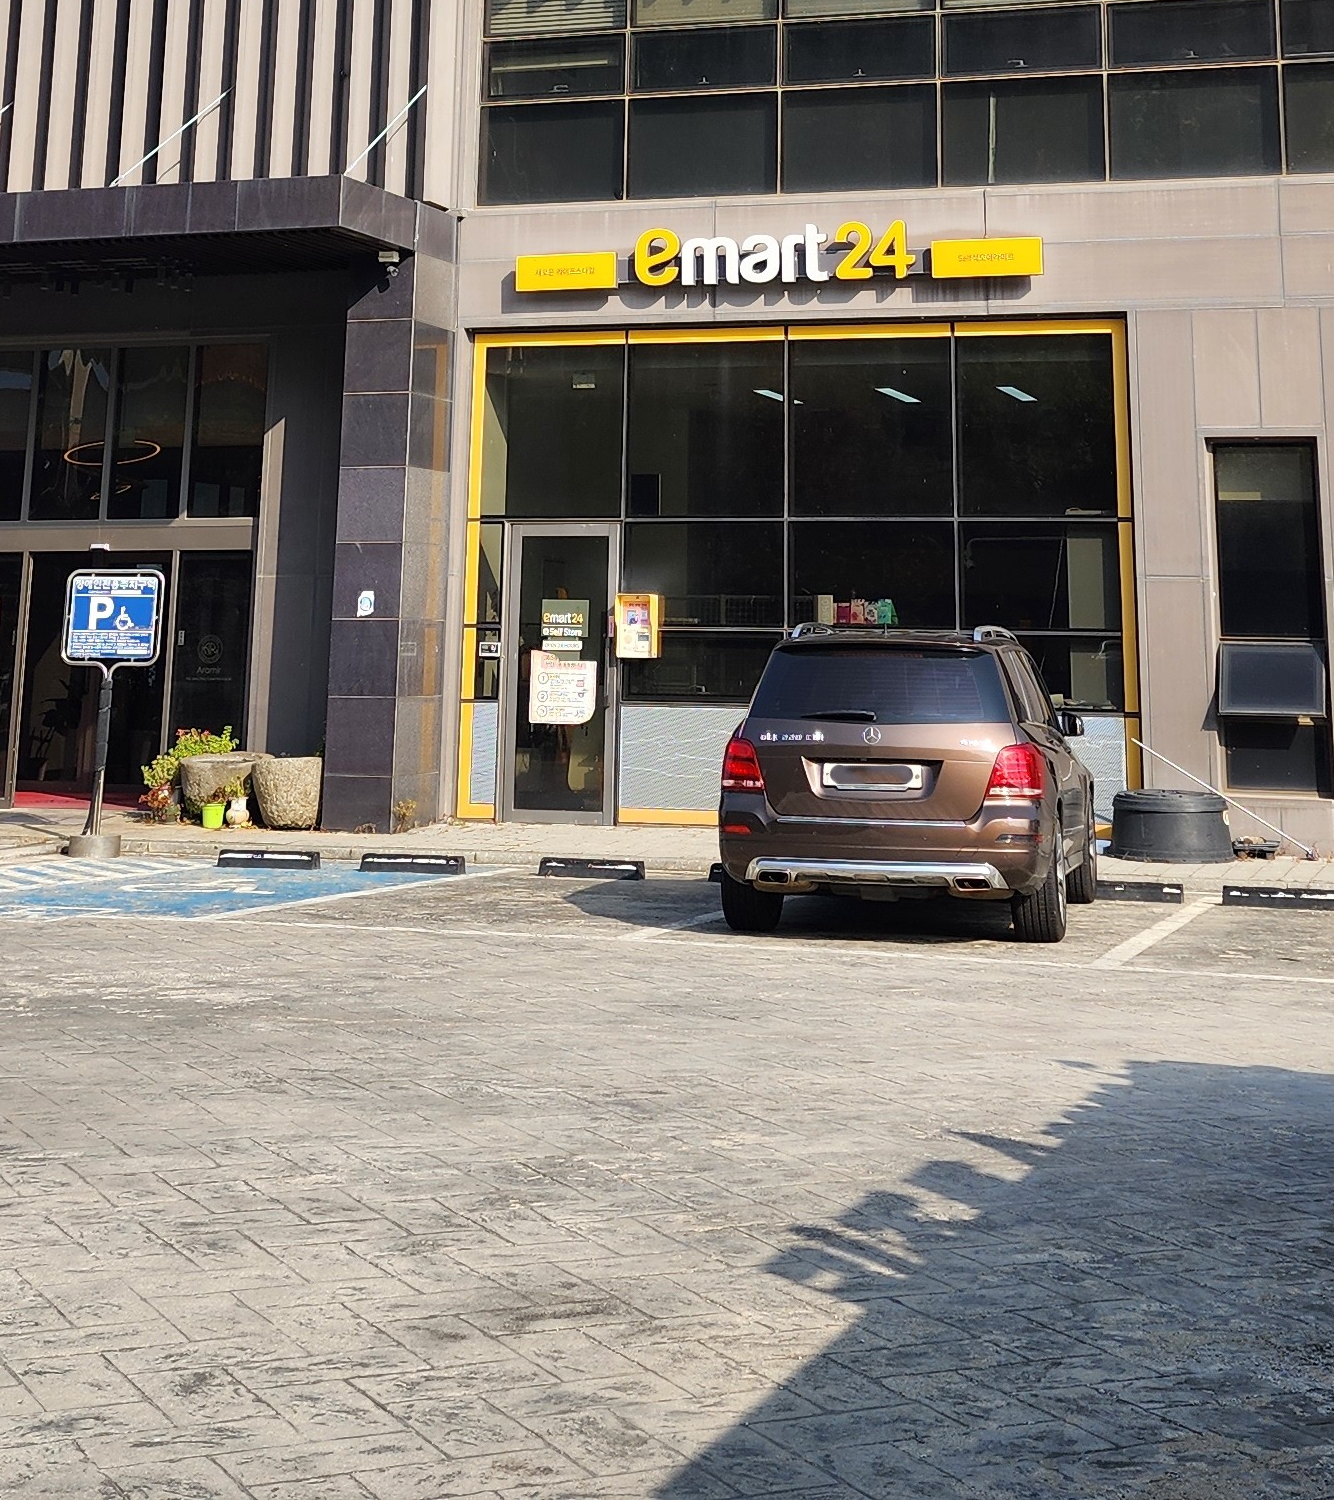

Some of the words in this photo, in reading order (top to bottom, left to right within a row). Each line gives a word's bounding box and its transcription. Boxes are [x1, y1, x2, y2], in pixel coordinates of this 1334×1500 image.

[634, 219, 916, 286] emart24
[88, 596, 114, 631] P
[543, 612, 584, 624] emart24
